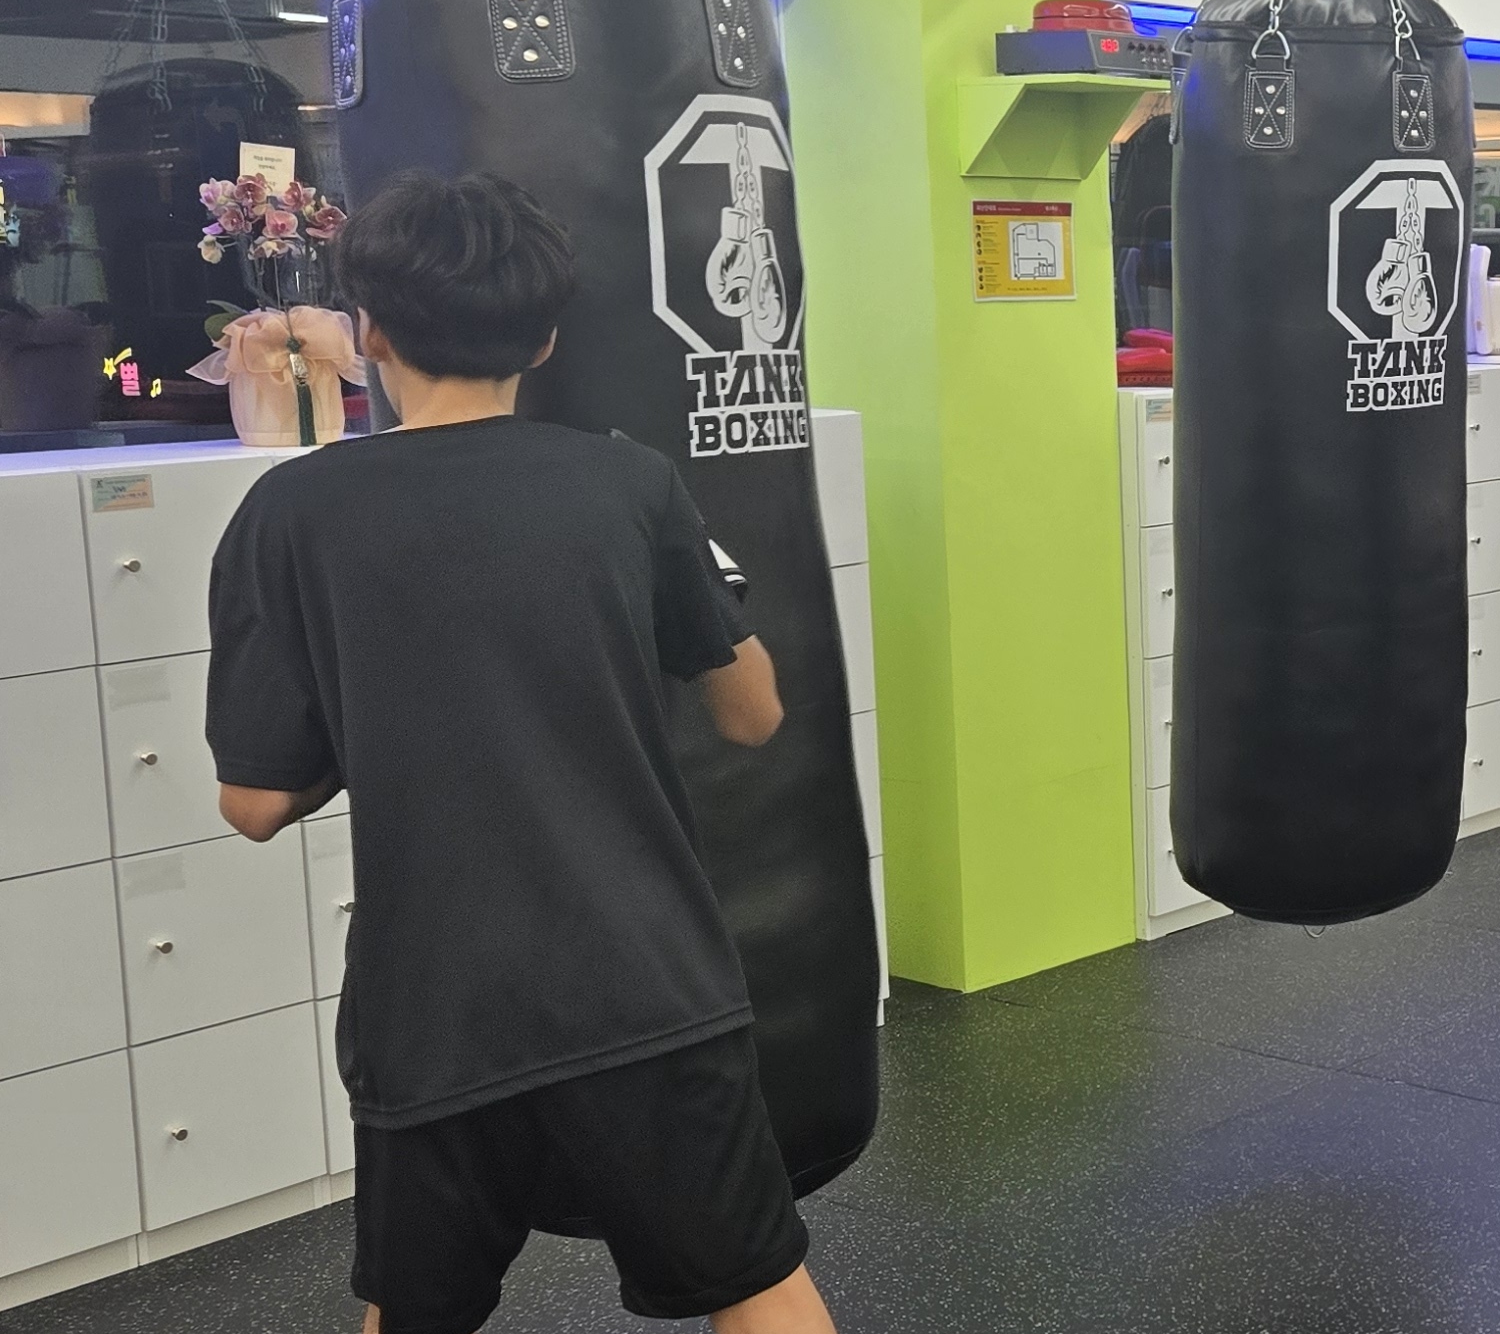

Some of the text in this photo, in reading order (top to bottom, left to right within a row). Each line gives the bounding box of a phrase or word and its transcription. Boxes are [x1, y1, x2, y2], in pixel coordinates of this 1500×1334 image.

[1349, 338, 1447, 379] TANK
[689, 353, 804, 409] TANK
[1349, 378, 1443, 409] BOXING
[692, 410, 808, 453] BOXING
